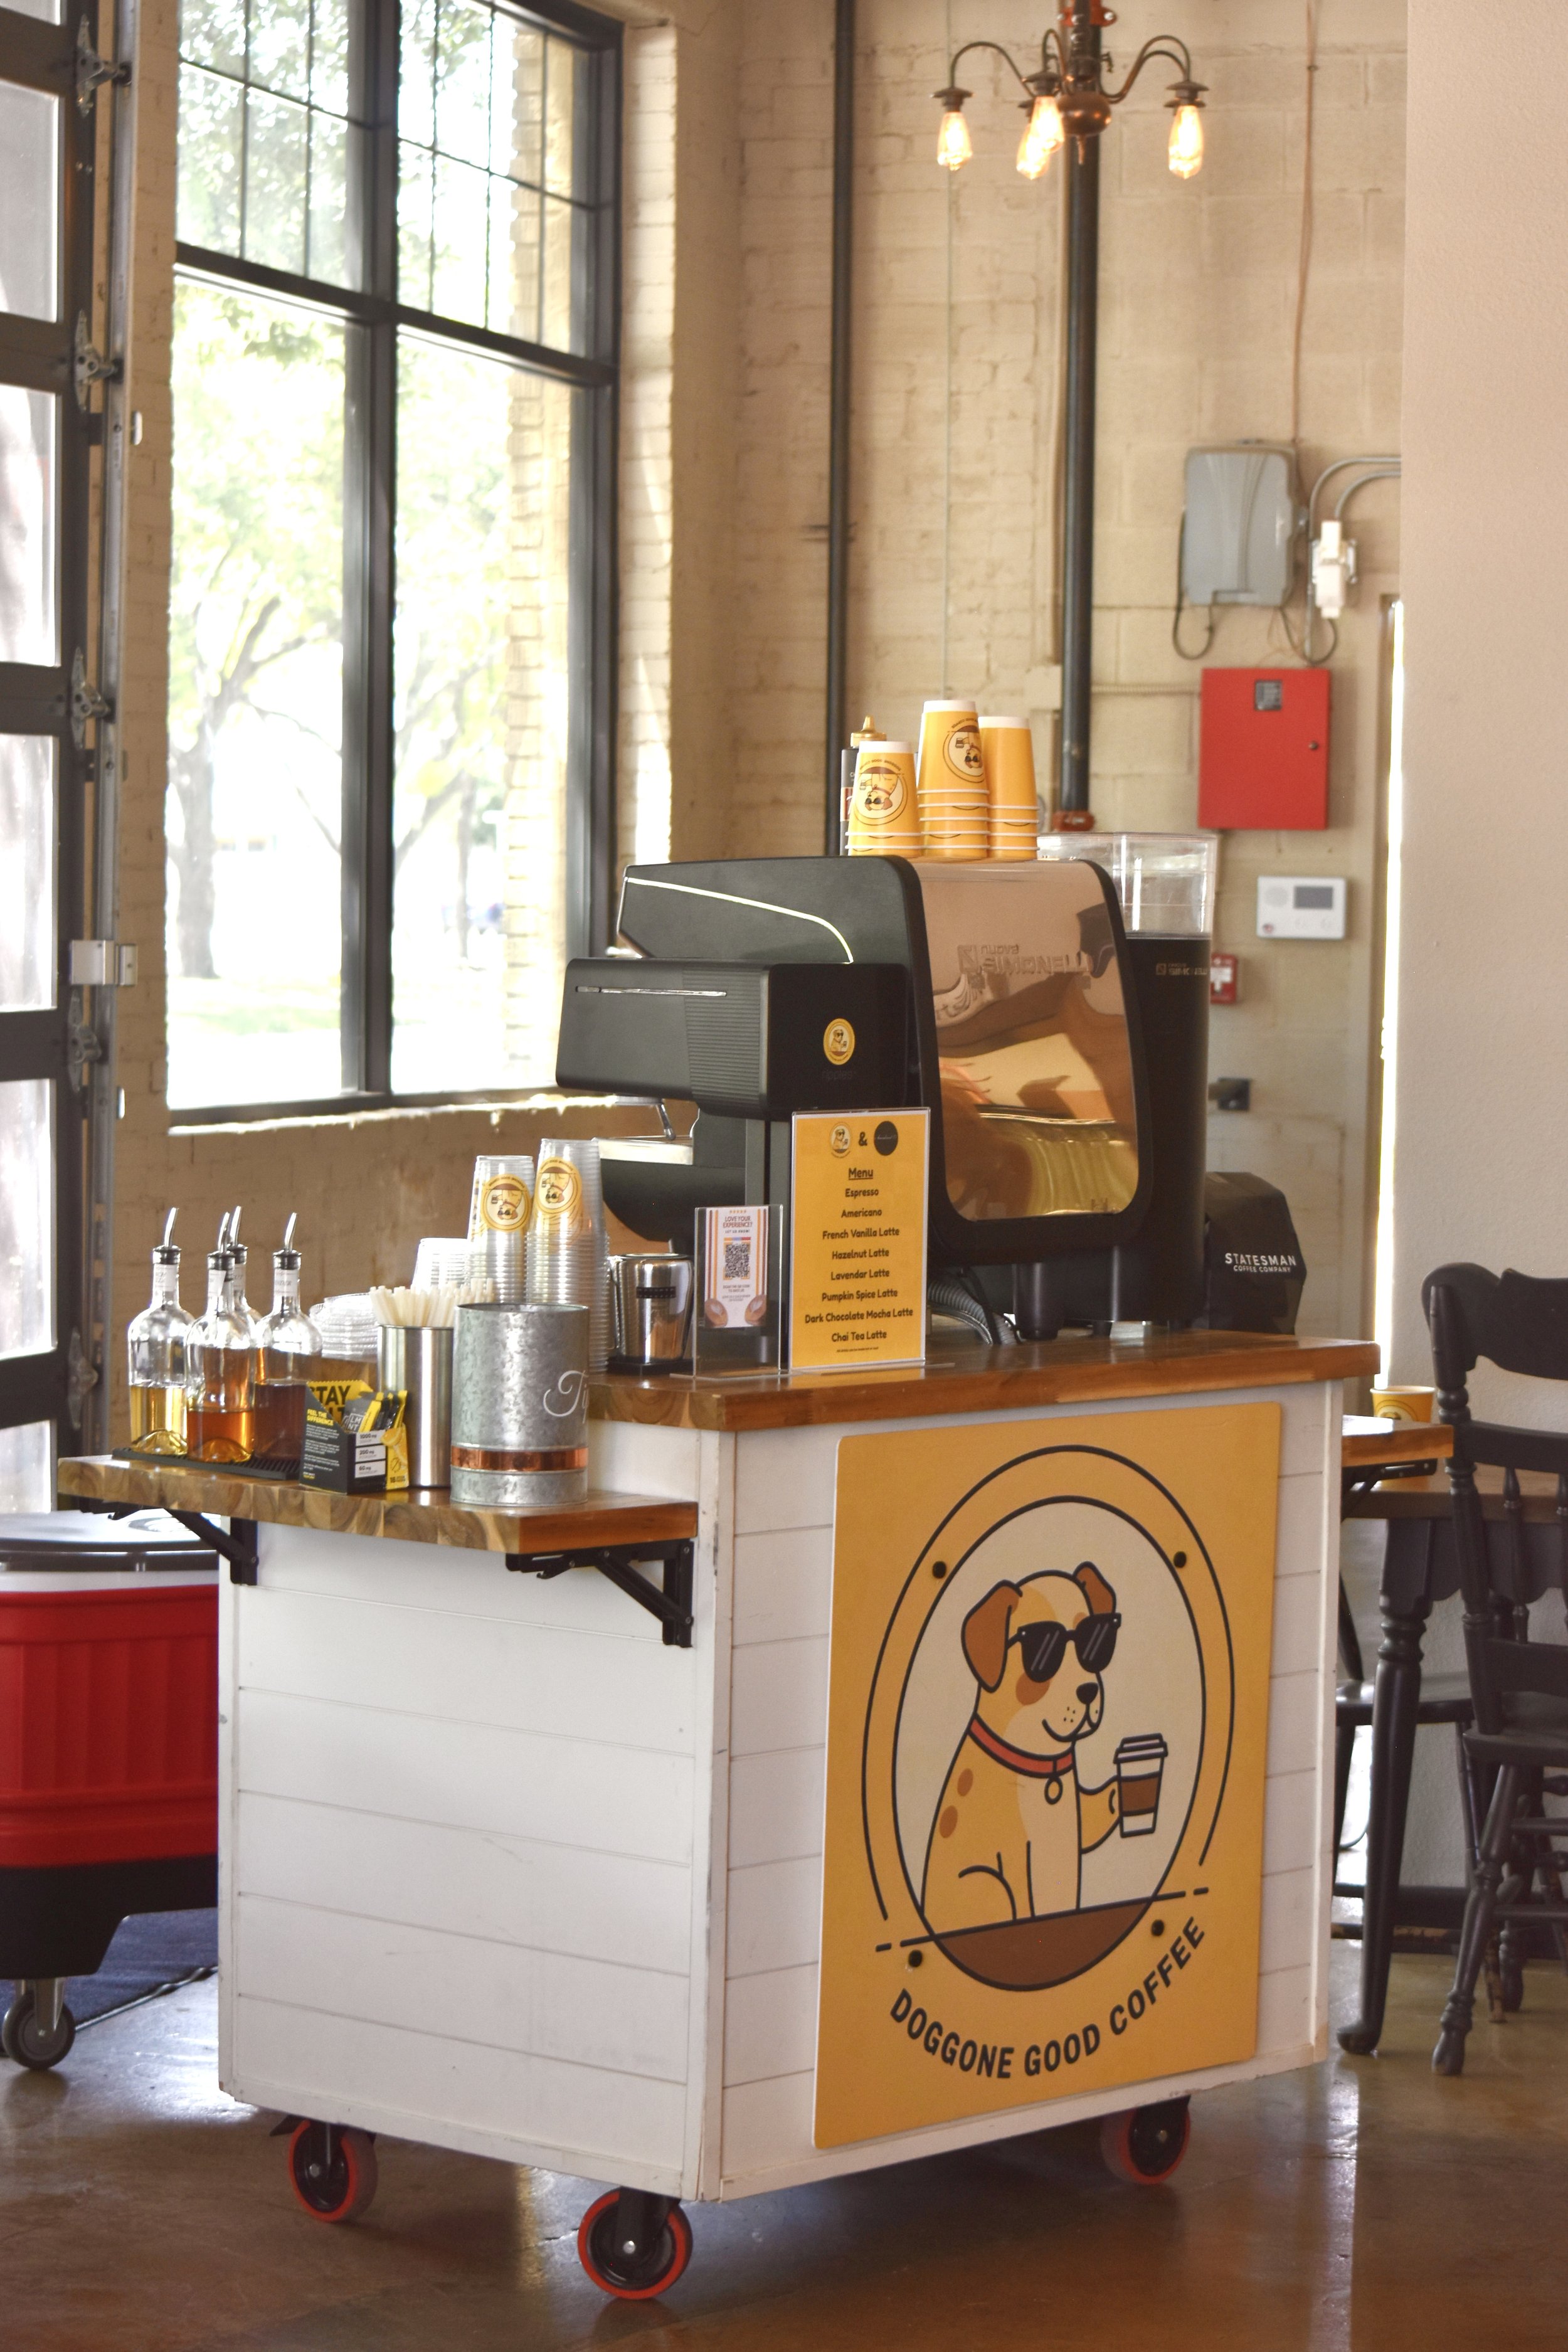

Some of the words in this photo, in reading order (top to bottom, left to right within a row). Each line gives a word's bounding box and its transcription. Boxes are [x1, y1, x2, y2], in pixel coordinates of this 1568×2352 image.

[858, 1131, 868, 1147] &
[848, 1167, 874, 1179] Menu
[845, 1188, 879, 1199] Espresso
[841, 1208, 882, 1218] Americano
[822, 1229, 849, 1239] French
[850, 1227, 877, 1238] Vanilla
[879, 1227, 899, 1236] Latte
[832, 1249, 867, 1259] Hazelnut
[869, 1248, 889, 1258] Latte
[1225, 1253, 1296, 1266] STATESMAN
[831, 1269, 867, 1280] Lavendar
[869, 1268, 890, 1278] Latte
[822, 1291, 854, 1303] Pumpkin
[856, 1290, 876, 1301] Spice
[877, 1288, 898, 1298] Latte
[805, 1313, 824, 1323] Dark
[825, 1311, 864, 1322] Chocolate
[866, 1309, 891, 1319] Mocha
[893, 1307, 913, 1317] Latte
[832, 1332, 849, 1342] Chai
[850, 1332, 865, 1340] Tea
[866, 1330, 887, 1340] Latte
[889, 1988, 1015, 2079] DOGGONE
[1024, 2023, 1101, 2077] GOOD
[1109, 1916, 1205, 2035] COFFEE
